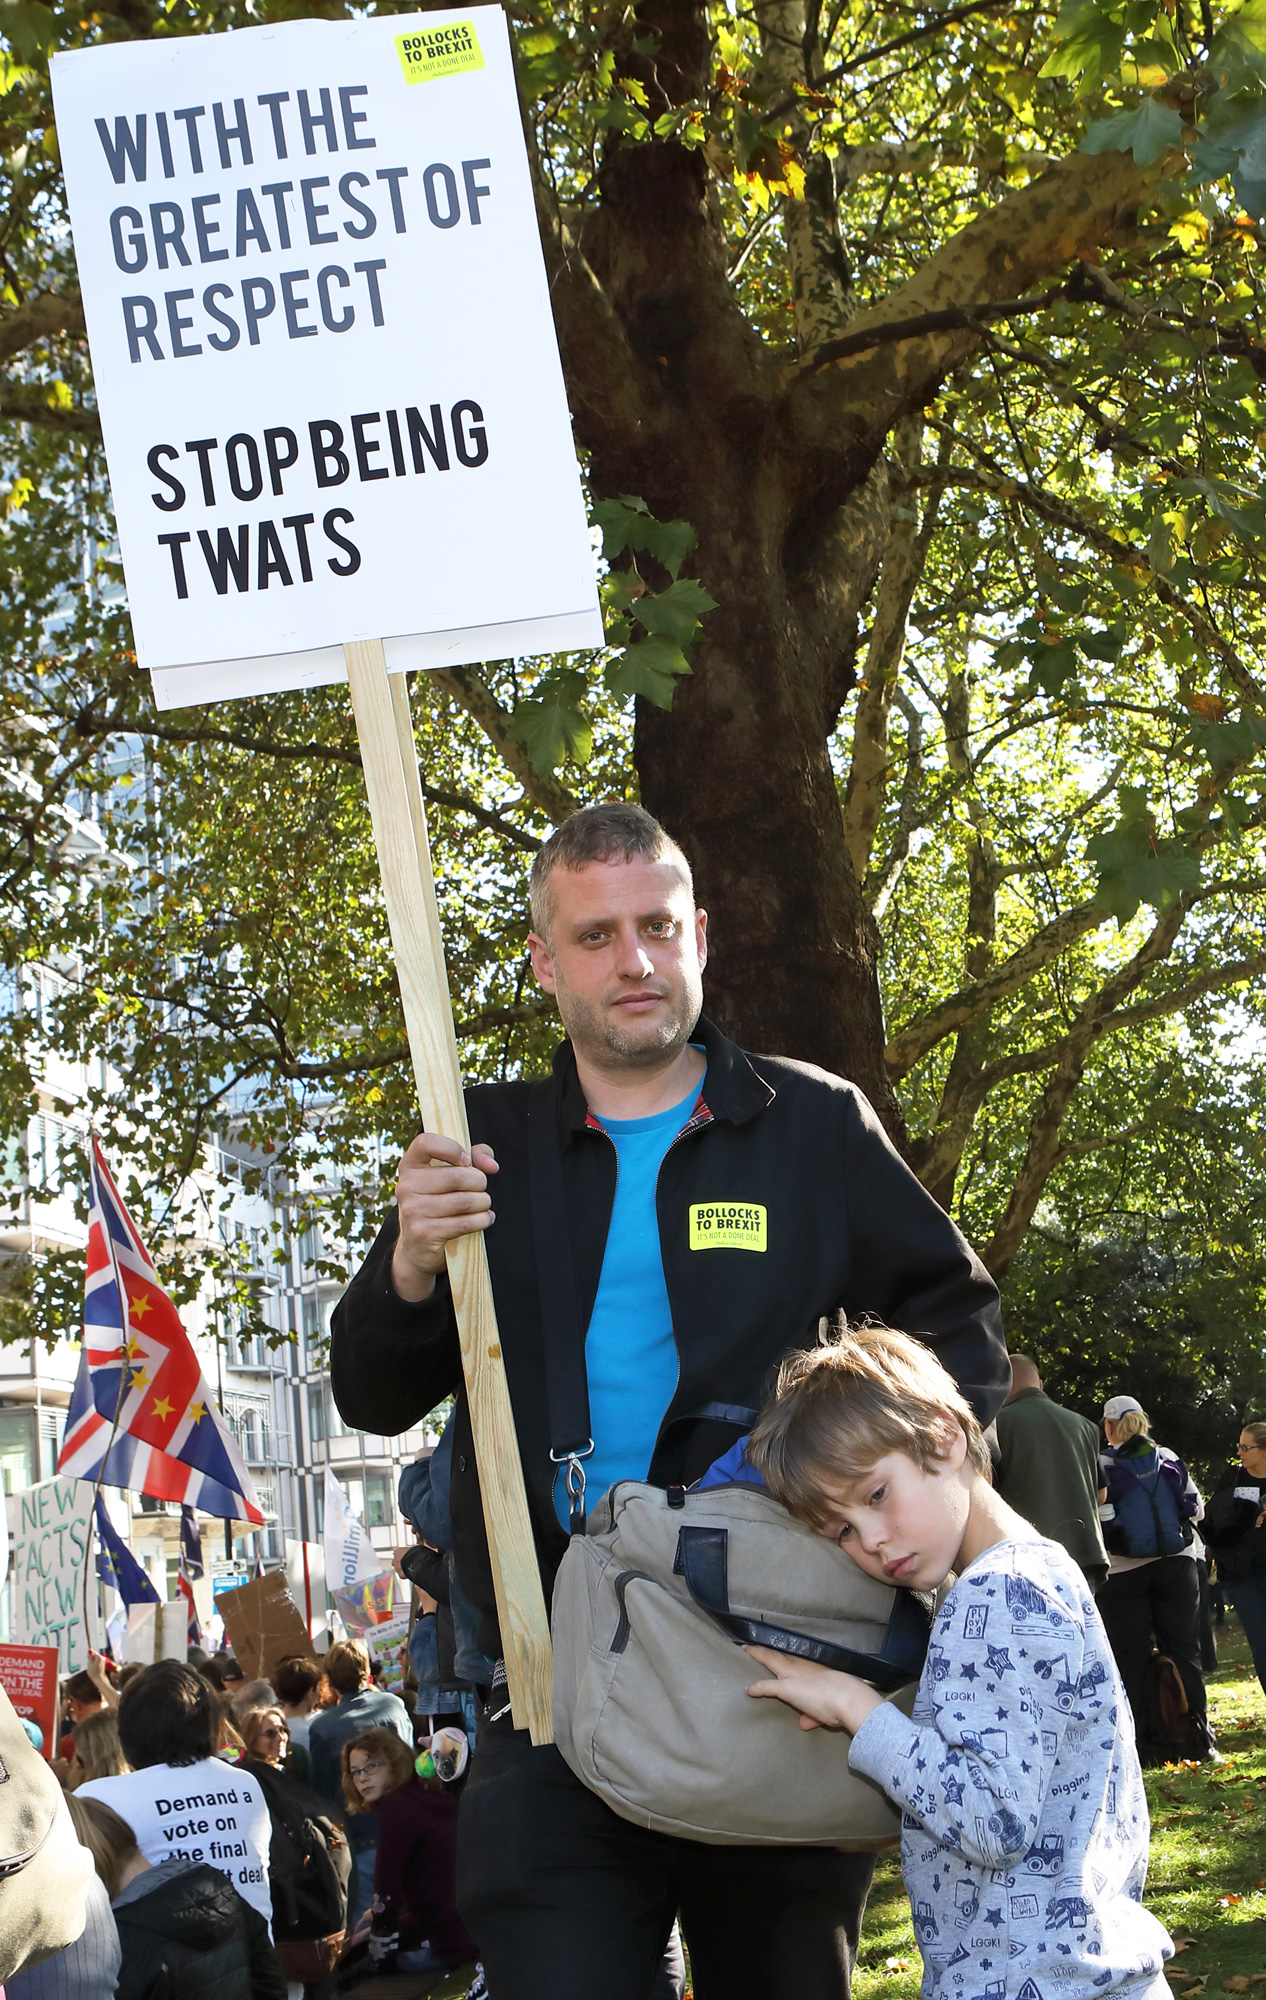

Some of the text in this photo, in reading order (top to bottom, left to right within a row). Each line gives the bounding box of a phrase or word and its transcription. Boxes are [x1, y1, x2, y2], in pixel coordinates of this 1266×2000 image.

[402, 26, 469, 51] BOLLOCKS
[405, 38, 473, 64] TO BREXIT
[410, 65, 423, 75] IT'S
[423, 61, 436, 72] NOT
[437, 61, 442, 69] A
[442, 57, 460, 68] DONE
[460, 53, 476, 63] DEAL
[94, 85, 377, 185] WITH THE
[109, 157, 492, 275] GREATEST OF
[121, 258, 387, 364] RESPECT
[146, 399, 489, 513] STOP BEING
[157, 507, 362, 600] TWATS
[696, 1219, 761, 1232] TO BREXIT
[697, 1208, 760, 1220] BOLLOCKS
[697, 1231, 760, 1242] IT'S NOT A DONE DEAL
[22, 1479, 78, 1534] NEW
[15, 1517, 87, 1586] FACTS
[25, 1569, 79, 1630] NEW
[22, 1616, 81, 1674] OTE
[18, 1676, 44, 1691] THE
[23, 1688, 43, 1698] DEAL
[945, 1691, 976, 1702] LOOK!
[1051, 1772, 1090, 1797] Digging
[155, 1788, 253, 1816] Demand a
[162, 1816, 238, 1842] vote on
[209, 1839, 248, 1860] final
[970, 1937, 1001, 1948] LOOK!
